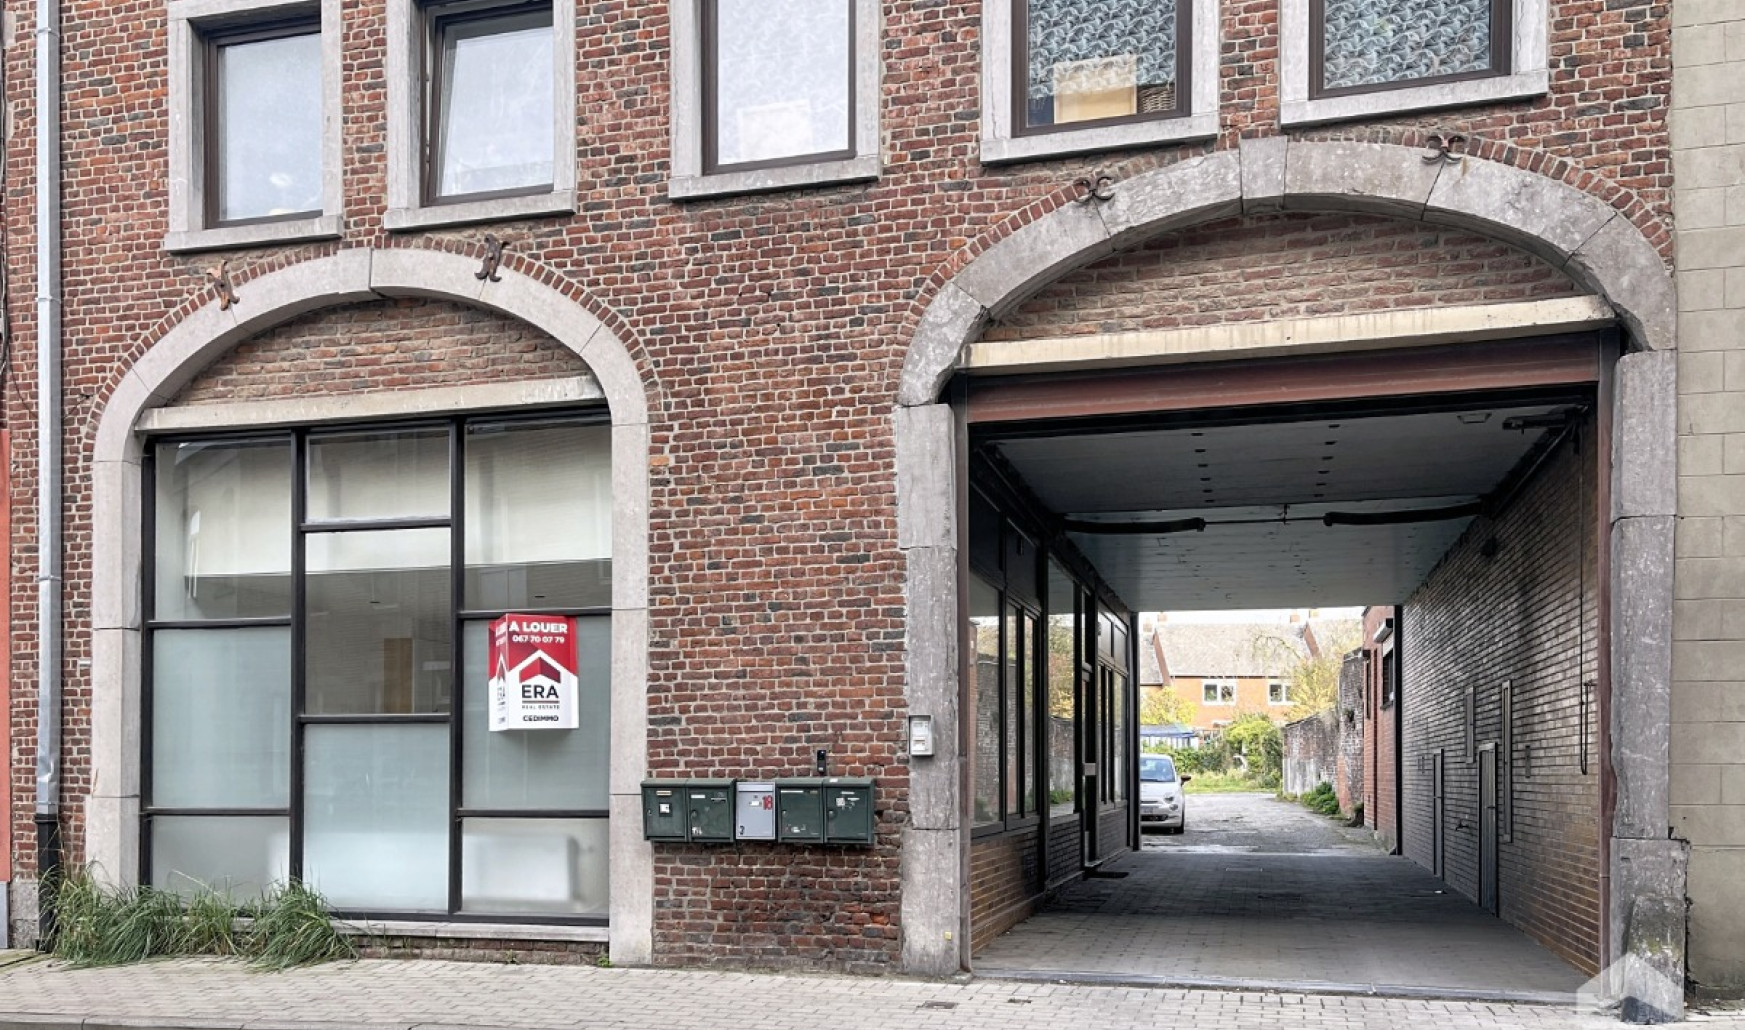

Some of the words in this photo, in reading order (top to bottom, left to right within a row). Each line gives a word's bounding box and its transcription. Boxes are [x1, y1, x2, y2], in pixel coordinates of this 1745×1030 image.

[509, 621, 519, 631] A
[522, 621, 567, 634] LOUER
[530, 635, 541, 643] 70
[522, 685, 559, 698] ERA
